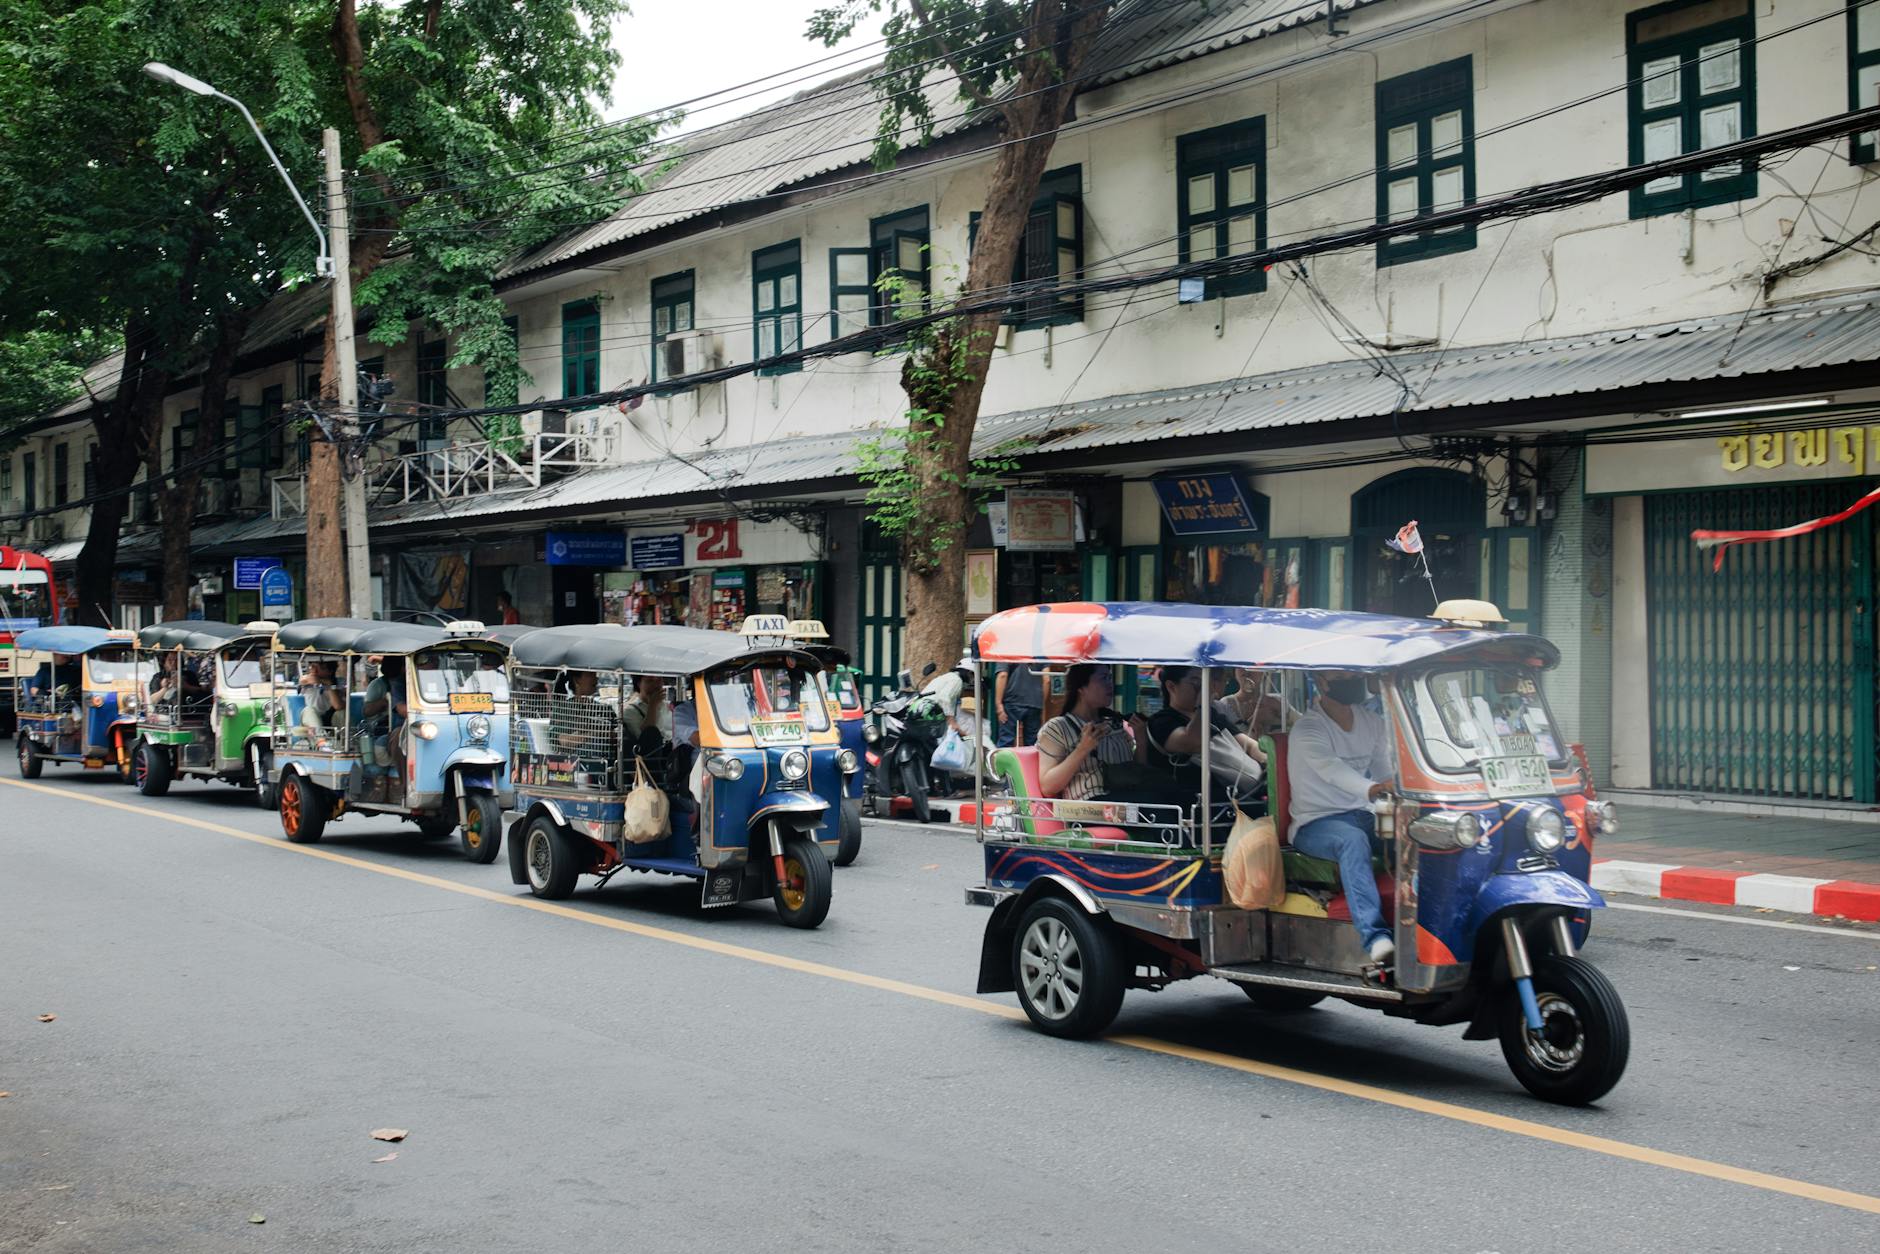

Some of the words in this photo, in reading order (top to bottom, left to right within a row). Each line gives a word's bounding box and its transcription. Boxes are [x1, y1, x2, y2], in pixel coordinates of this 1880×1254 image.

[754, 618, 784, 631] TAXI
[796, 623, 820, 634] TAXI
[780, 723, 801, 736] 240
